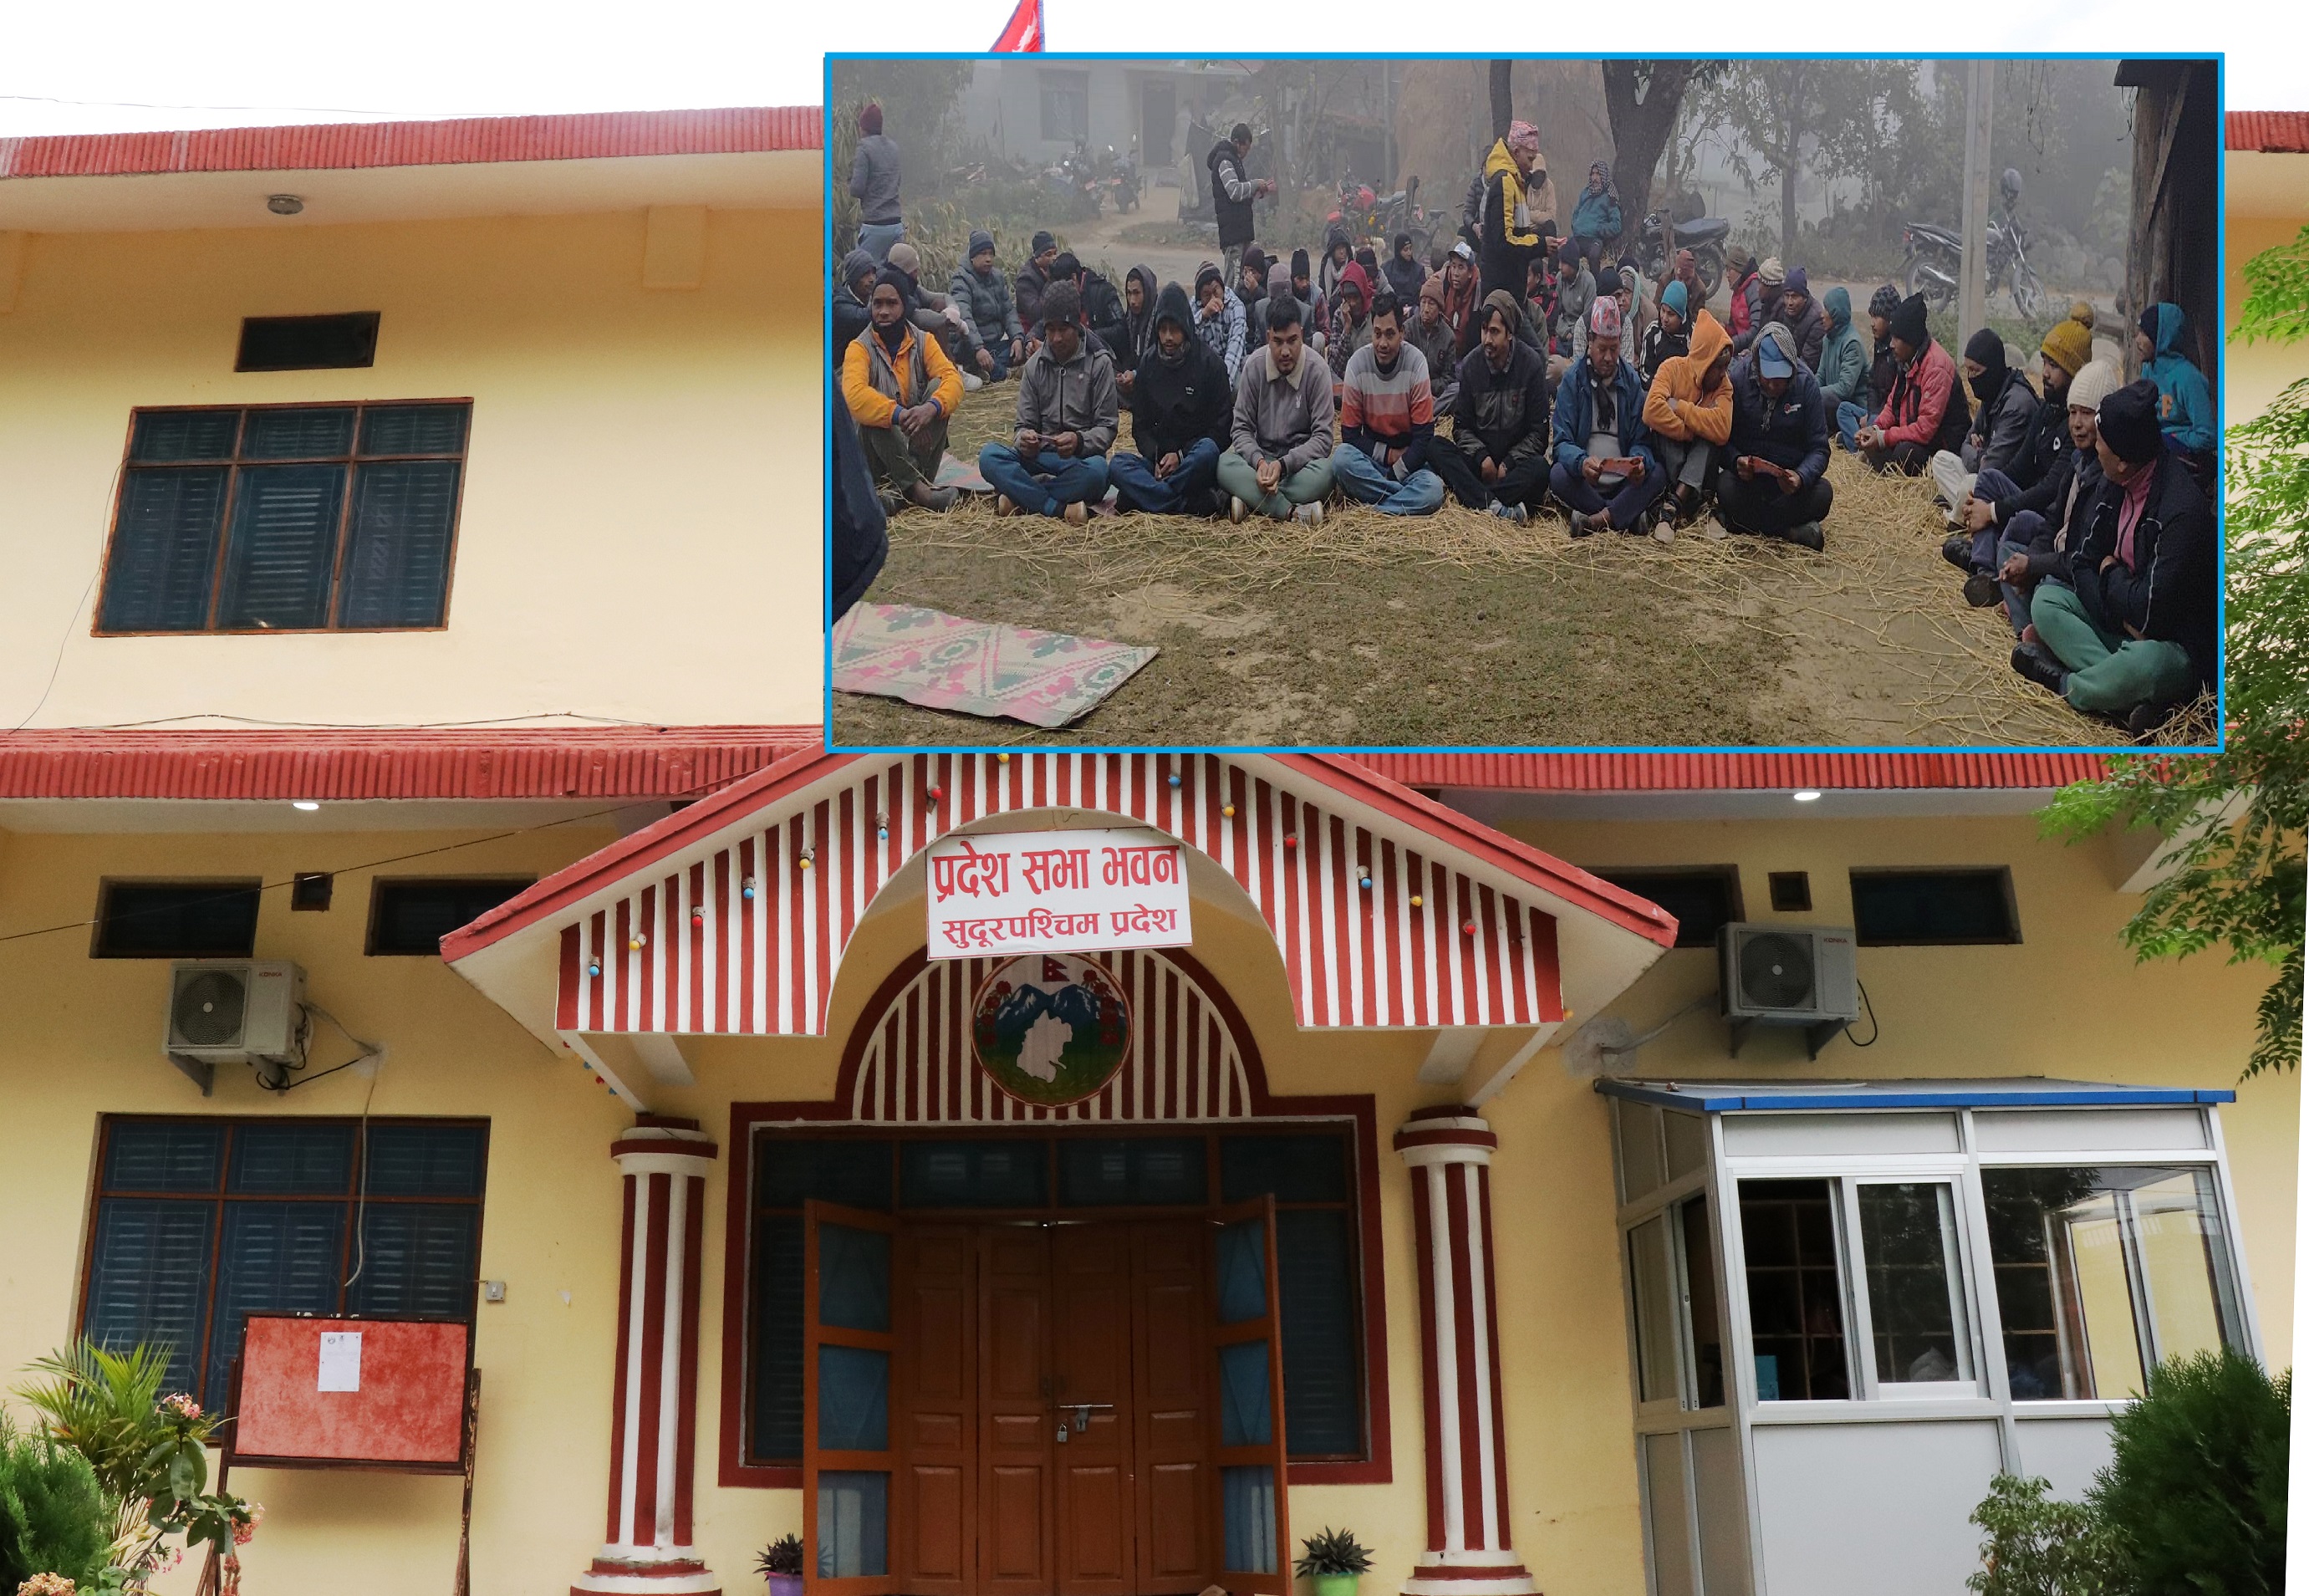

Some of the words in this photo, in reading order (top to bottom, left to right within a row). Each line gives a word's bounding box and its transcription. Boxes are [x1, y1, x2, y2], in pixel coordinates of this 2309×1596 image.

[932, 840, 1011, 903] प्रदेश
[1022, 849, 1090, 895] सभा
[1102, 845, 1180, 887] भवन
[942, 907, 1100, 949] सुदूरपश्चिम
[1110, 903, 1178, 936] प्रदेश
